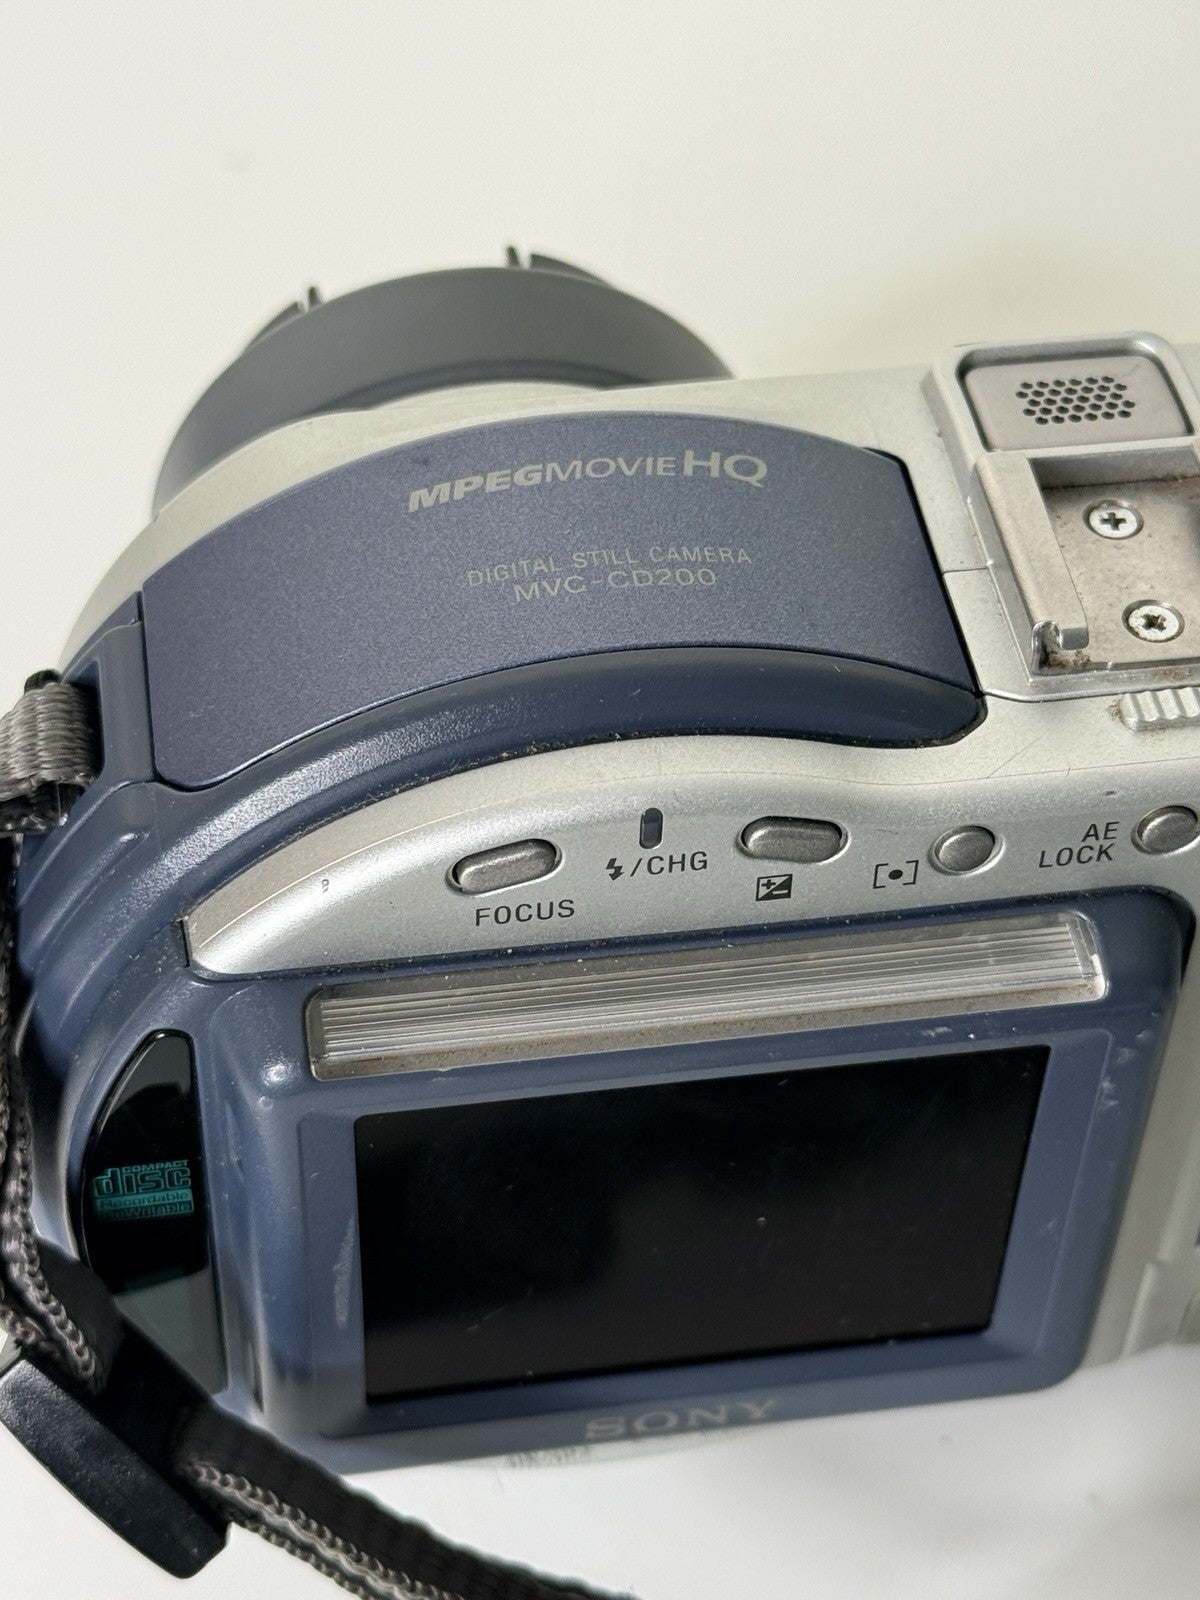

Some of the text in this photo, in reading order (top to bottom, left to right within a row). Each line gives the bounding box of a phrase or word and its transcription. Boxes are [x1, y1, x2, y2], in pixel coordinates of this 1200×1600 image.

[467, 546, 753, 588] DIGITAL STILL CAMERA
[513, 567, 717, 602] MVC-CD200
[1081, 821, 1120, 843] AE
[1038, 843, 1116, 868] LOCK
[474, 899, 576, 927] FOCUS
[122, 1159, 189, 1174] COMPACT
[101, 1191, 189, 1208] Recordable
[584, 1400, 776, 1440] SONY
